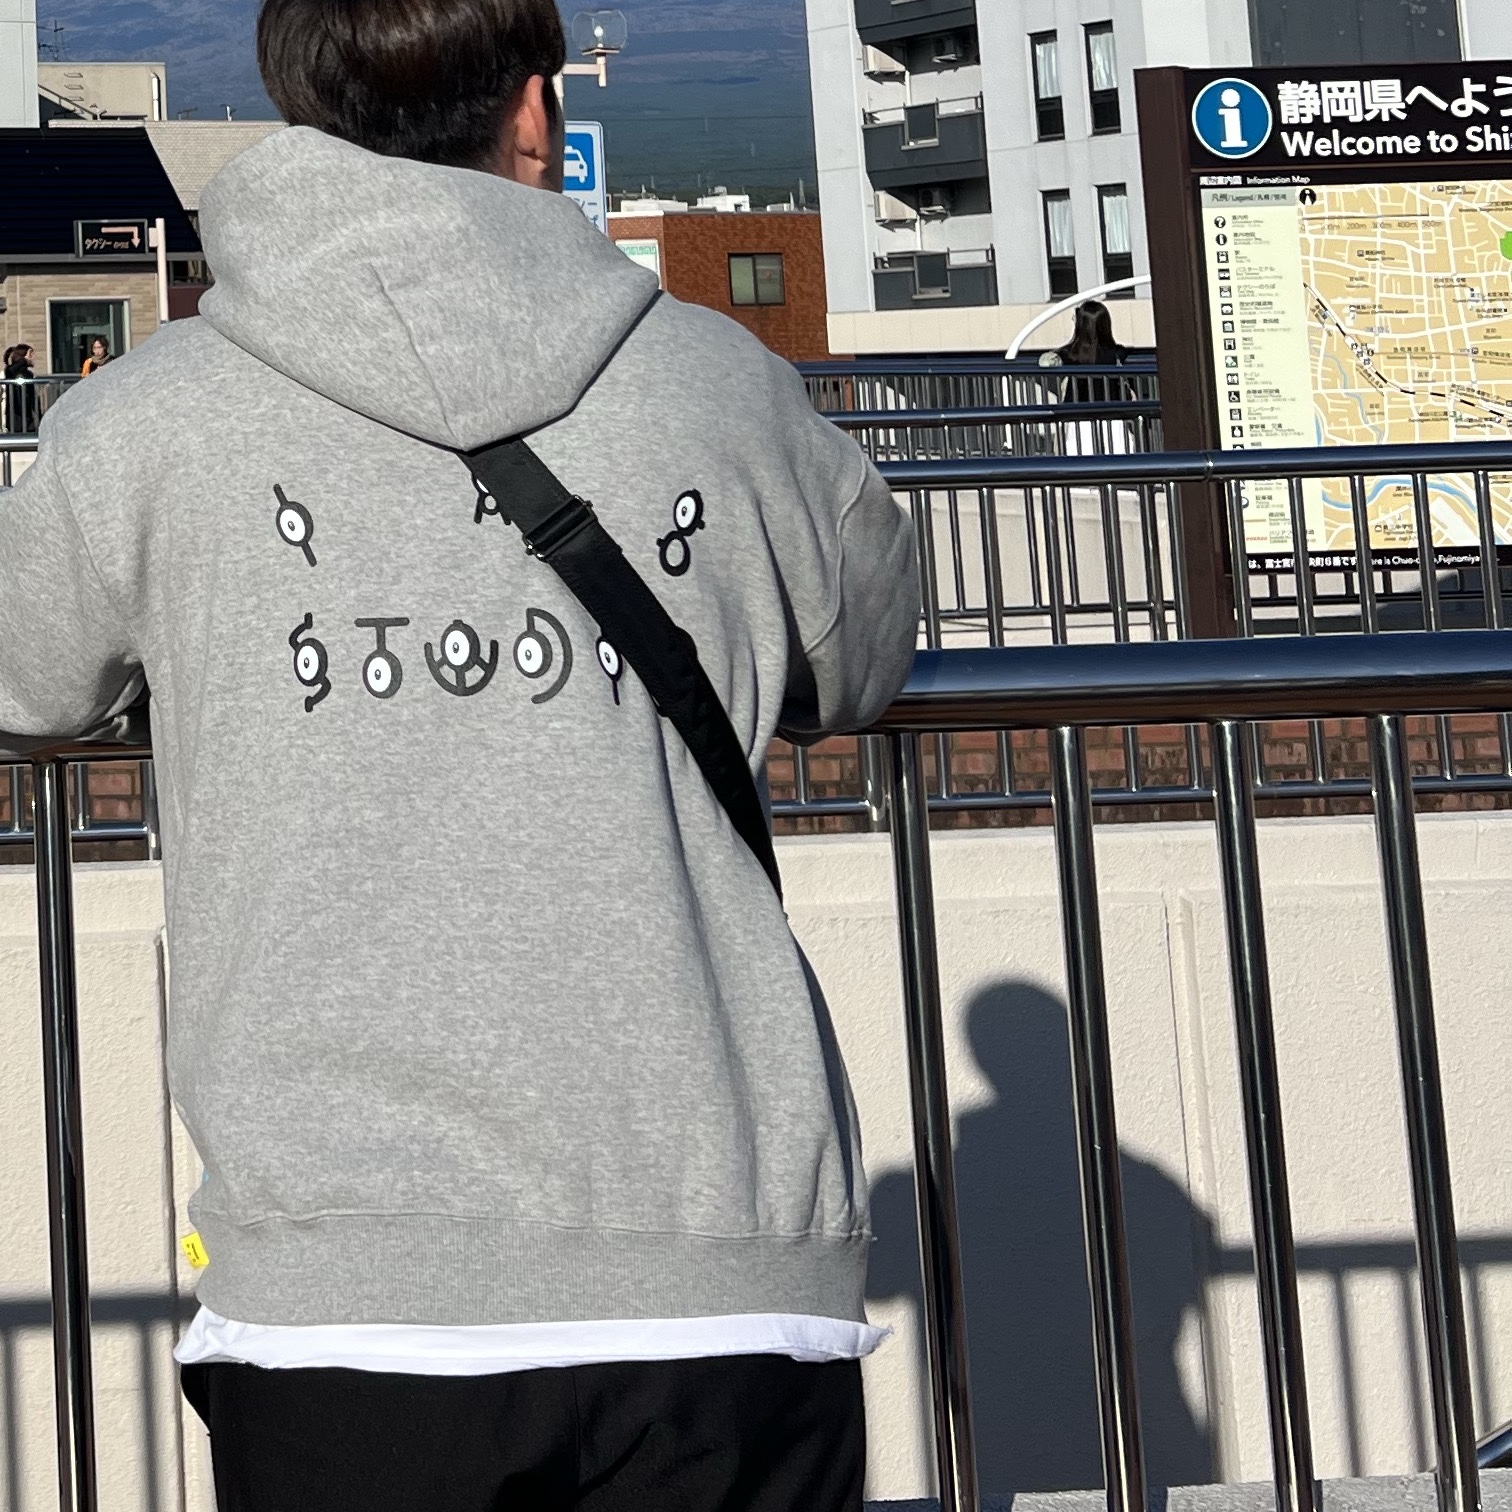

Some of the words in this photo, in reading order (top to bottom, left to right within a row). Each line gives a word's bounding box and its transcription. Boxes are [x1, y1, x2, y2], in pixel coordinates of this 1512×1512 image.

[1281, 129, 1421, 158] Welcome
[1426, 130, 1459, 154] to
[1465, 124, 1512, 153] Shi
[1246, 176, 1290, 185] Information
[1291, 175, 1310, 184] Map
